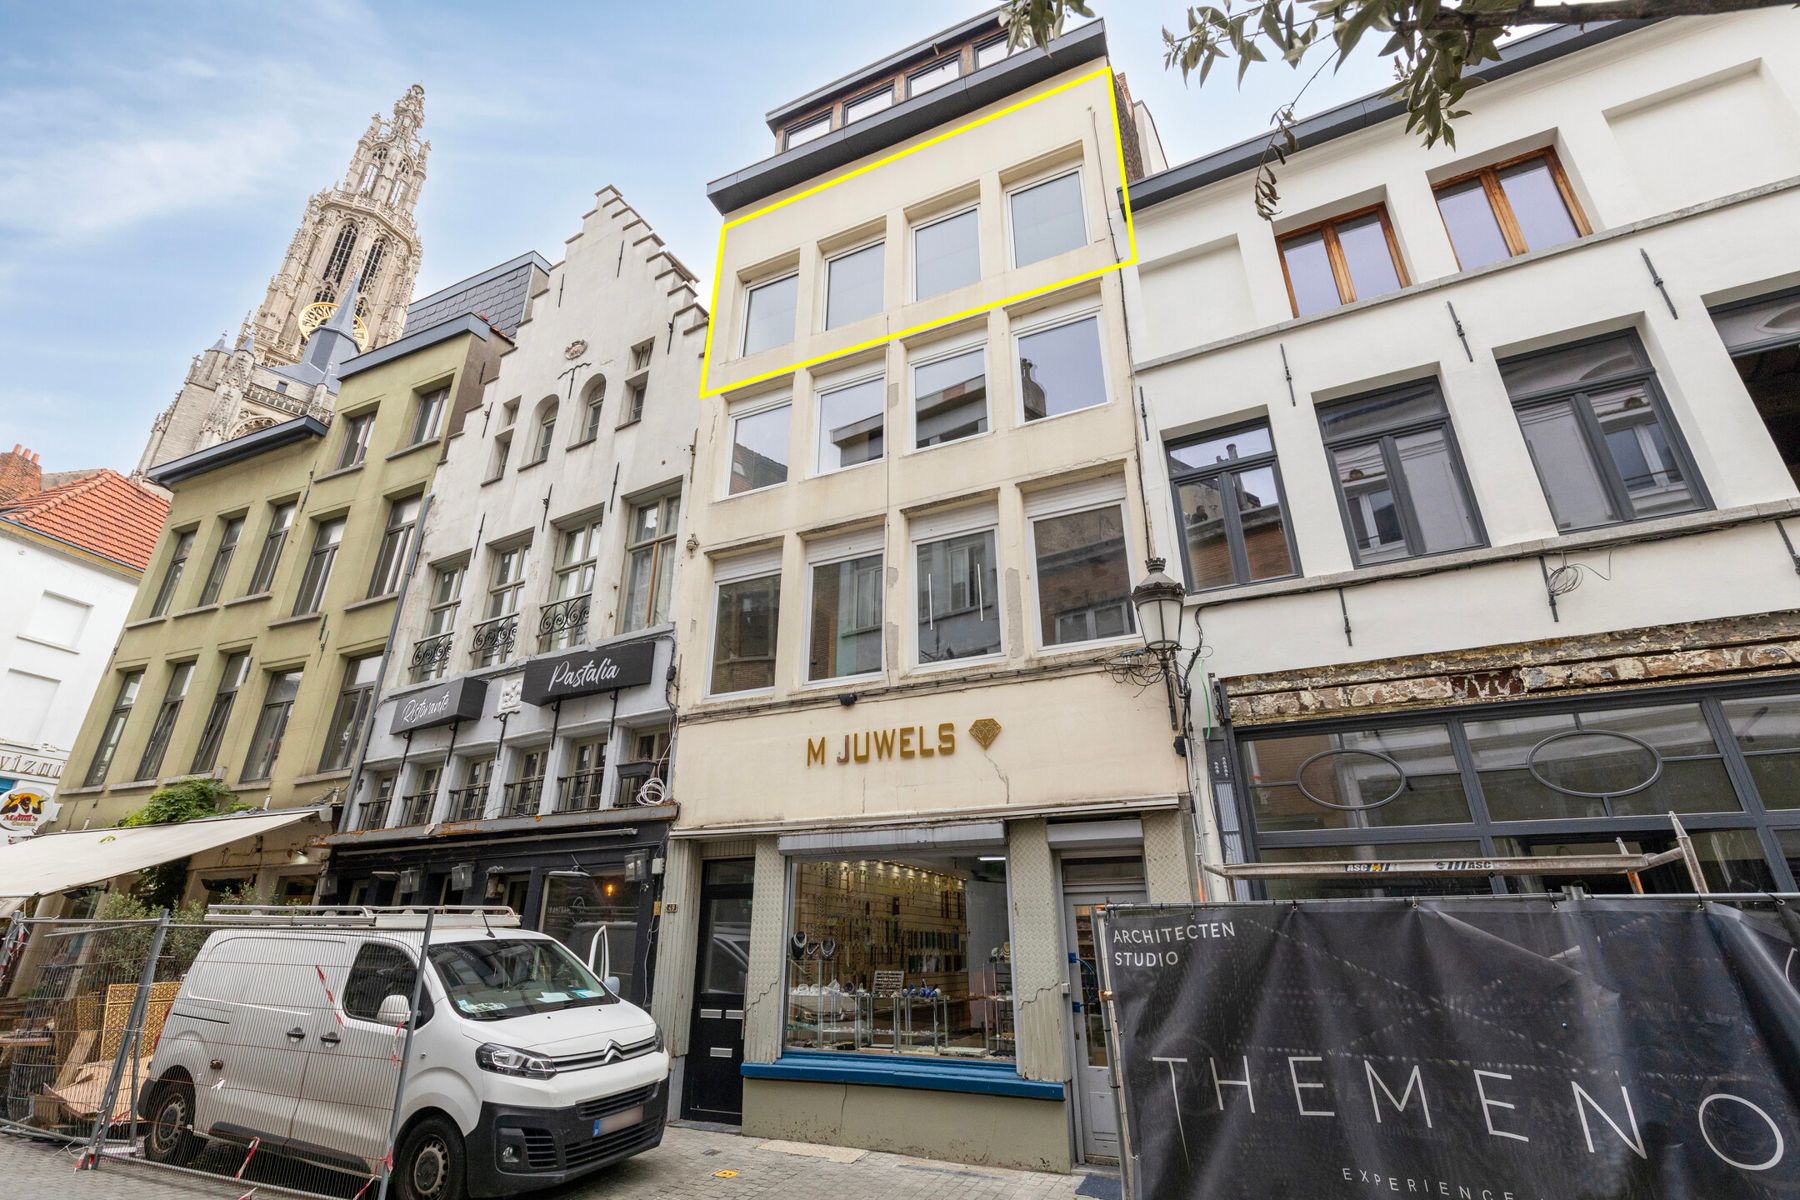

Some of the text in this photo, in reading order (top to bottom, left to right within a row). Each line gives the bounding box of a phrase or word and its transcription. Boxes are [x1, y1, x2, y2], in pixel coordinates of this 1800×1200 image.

[548, 658, 621, 692] Pastalia
[402, 691, 450, 723] Ristorante
[807, 722, 956, 767] M JUWELS
[1347, 863, 1369, 872] ASC
[1113, 921, 1236, 944] ARCHITECTEN
[1114, 951, 1179, 967] STUDIO
[1342, 1167, 1514, 1200] EXPERIENCE
